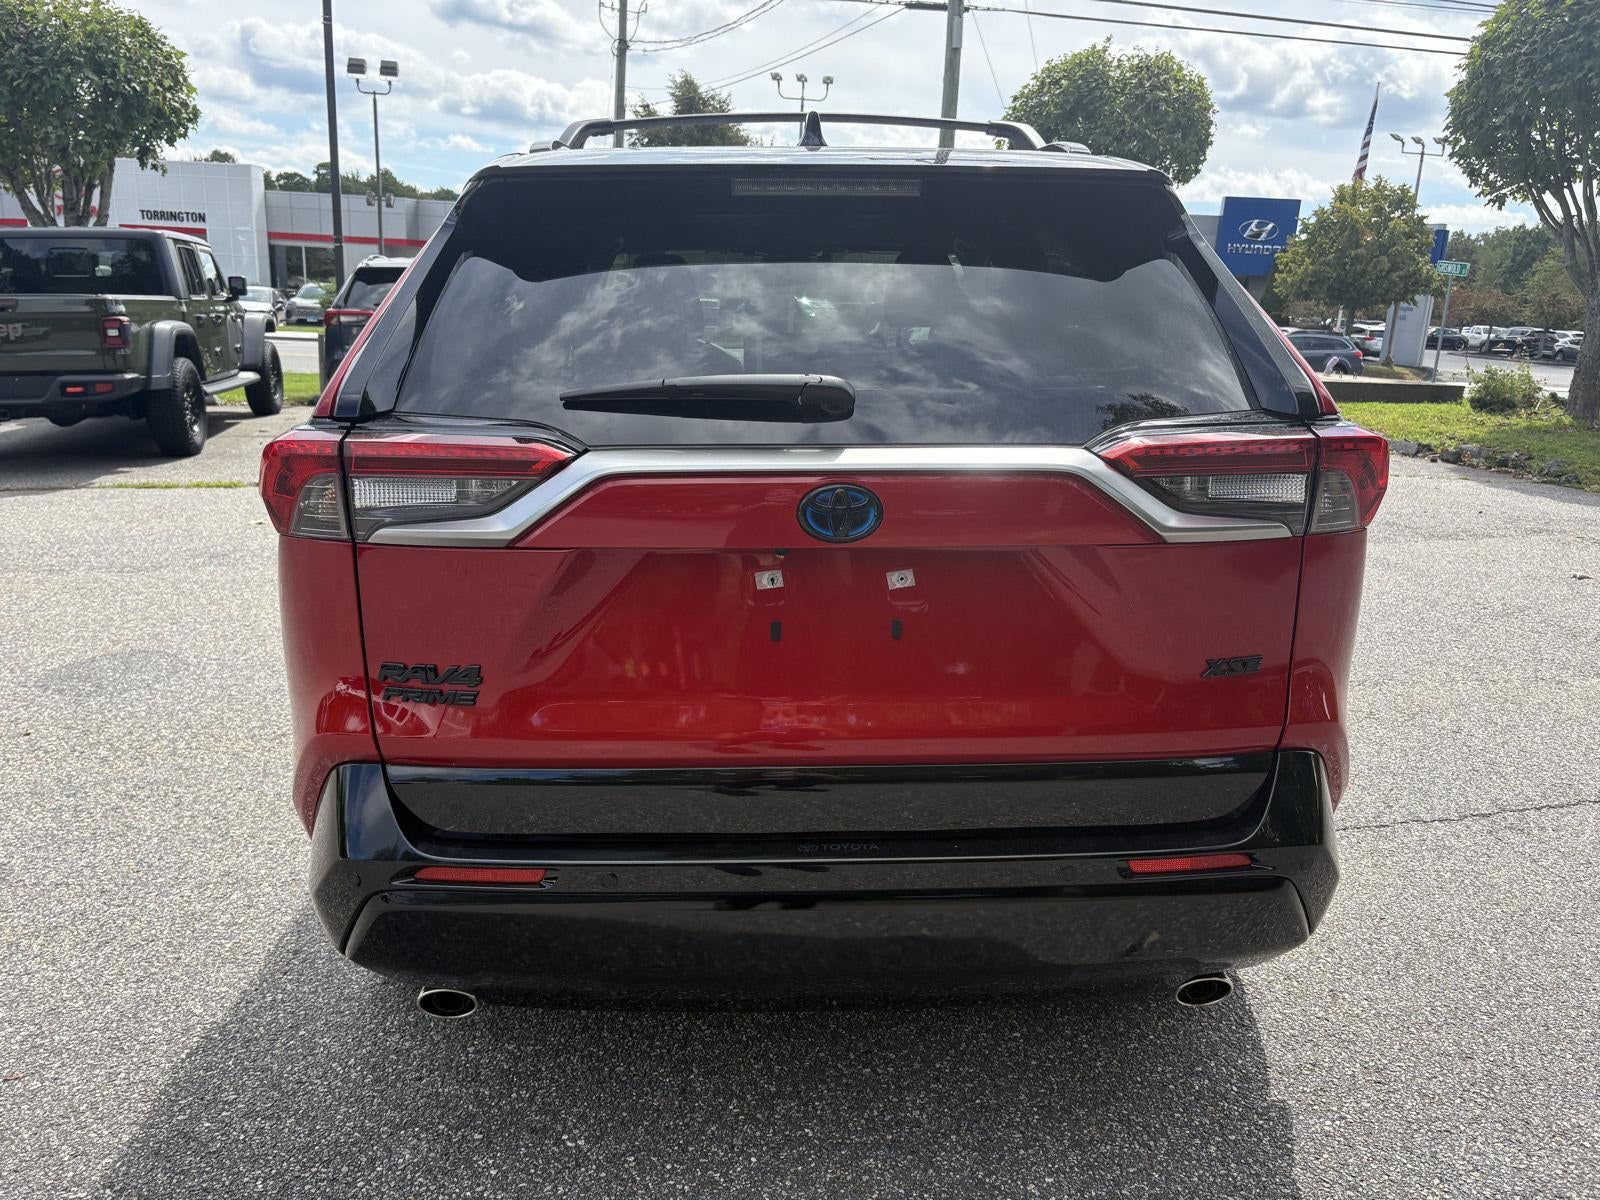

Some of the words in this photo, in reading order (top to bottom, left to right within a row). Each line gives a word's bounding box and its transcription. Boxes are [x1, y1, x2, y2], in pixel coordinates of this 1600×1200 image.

[139, 209, 206, 223] TORRINGTON
[1227, 243, 1285, 255] HYUNDA
[0, 323, 22, 340] ep
[377, 662, 483, 687] RAV4
[1200, 655, 1263, 679] XSE
[382, 686, 479, 706] PRIME
[822, 843, 880, 851] TOYOTA
